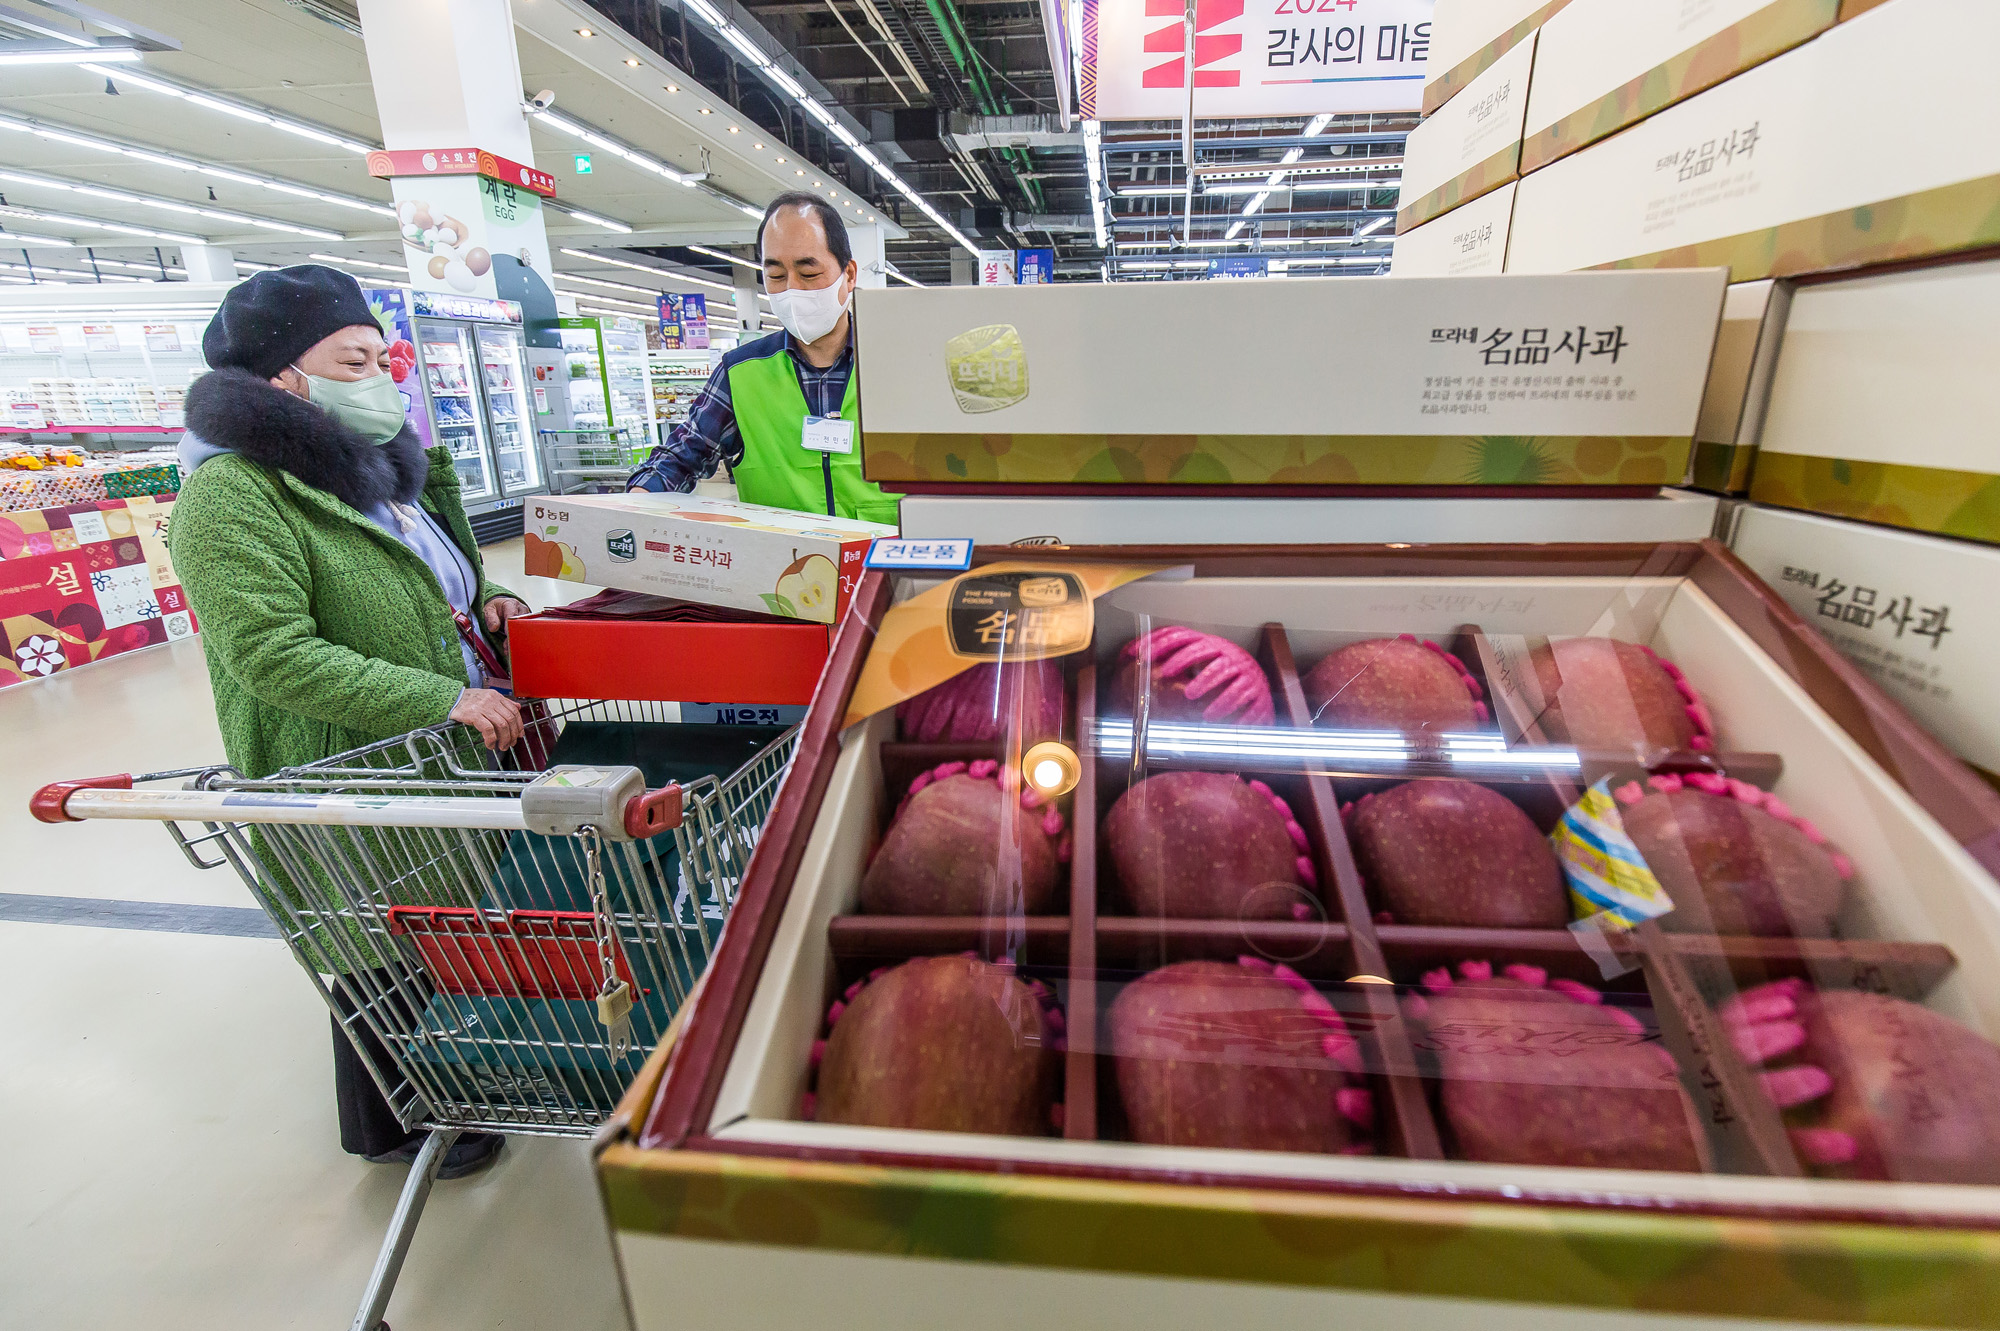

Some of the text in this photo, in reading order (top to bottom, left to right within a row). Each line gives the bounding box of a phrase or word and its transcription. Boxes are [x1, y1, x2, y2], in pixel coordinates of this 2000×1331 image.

[1267, 25, 1365, 66] 감사의
[1678, 121, 1761, 182] 名品사과
[484, 178, 517, 208] 계란
[495, 205, 515, 221] EGG
[1429, 325, 1629, 366] 뜨라네 名品사과
[957, 360, 1018, 383] 뜨라네
[547, 510, 570, 522] 농협
[609, 540, 634, 553] 뜨라네
[884, 544, 957, 560] 견본품
[46, 562, 83, 596] 설
[164, 592, 181, 608] 설
[1816, 578, 1952, 650] 名品사과
[973, 610, 1063, 646] 名品
